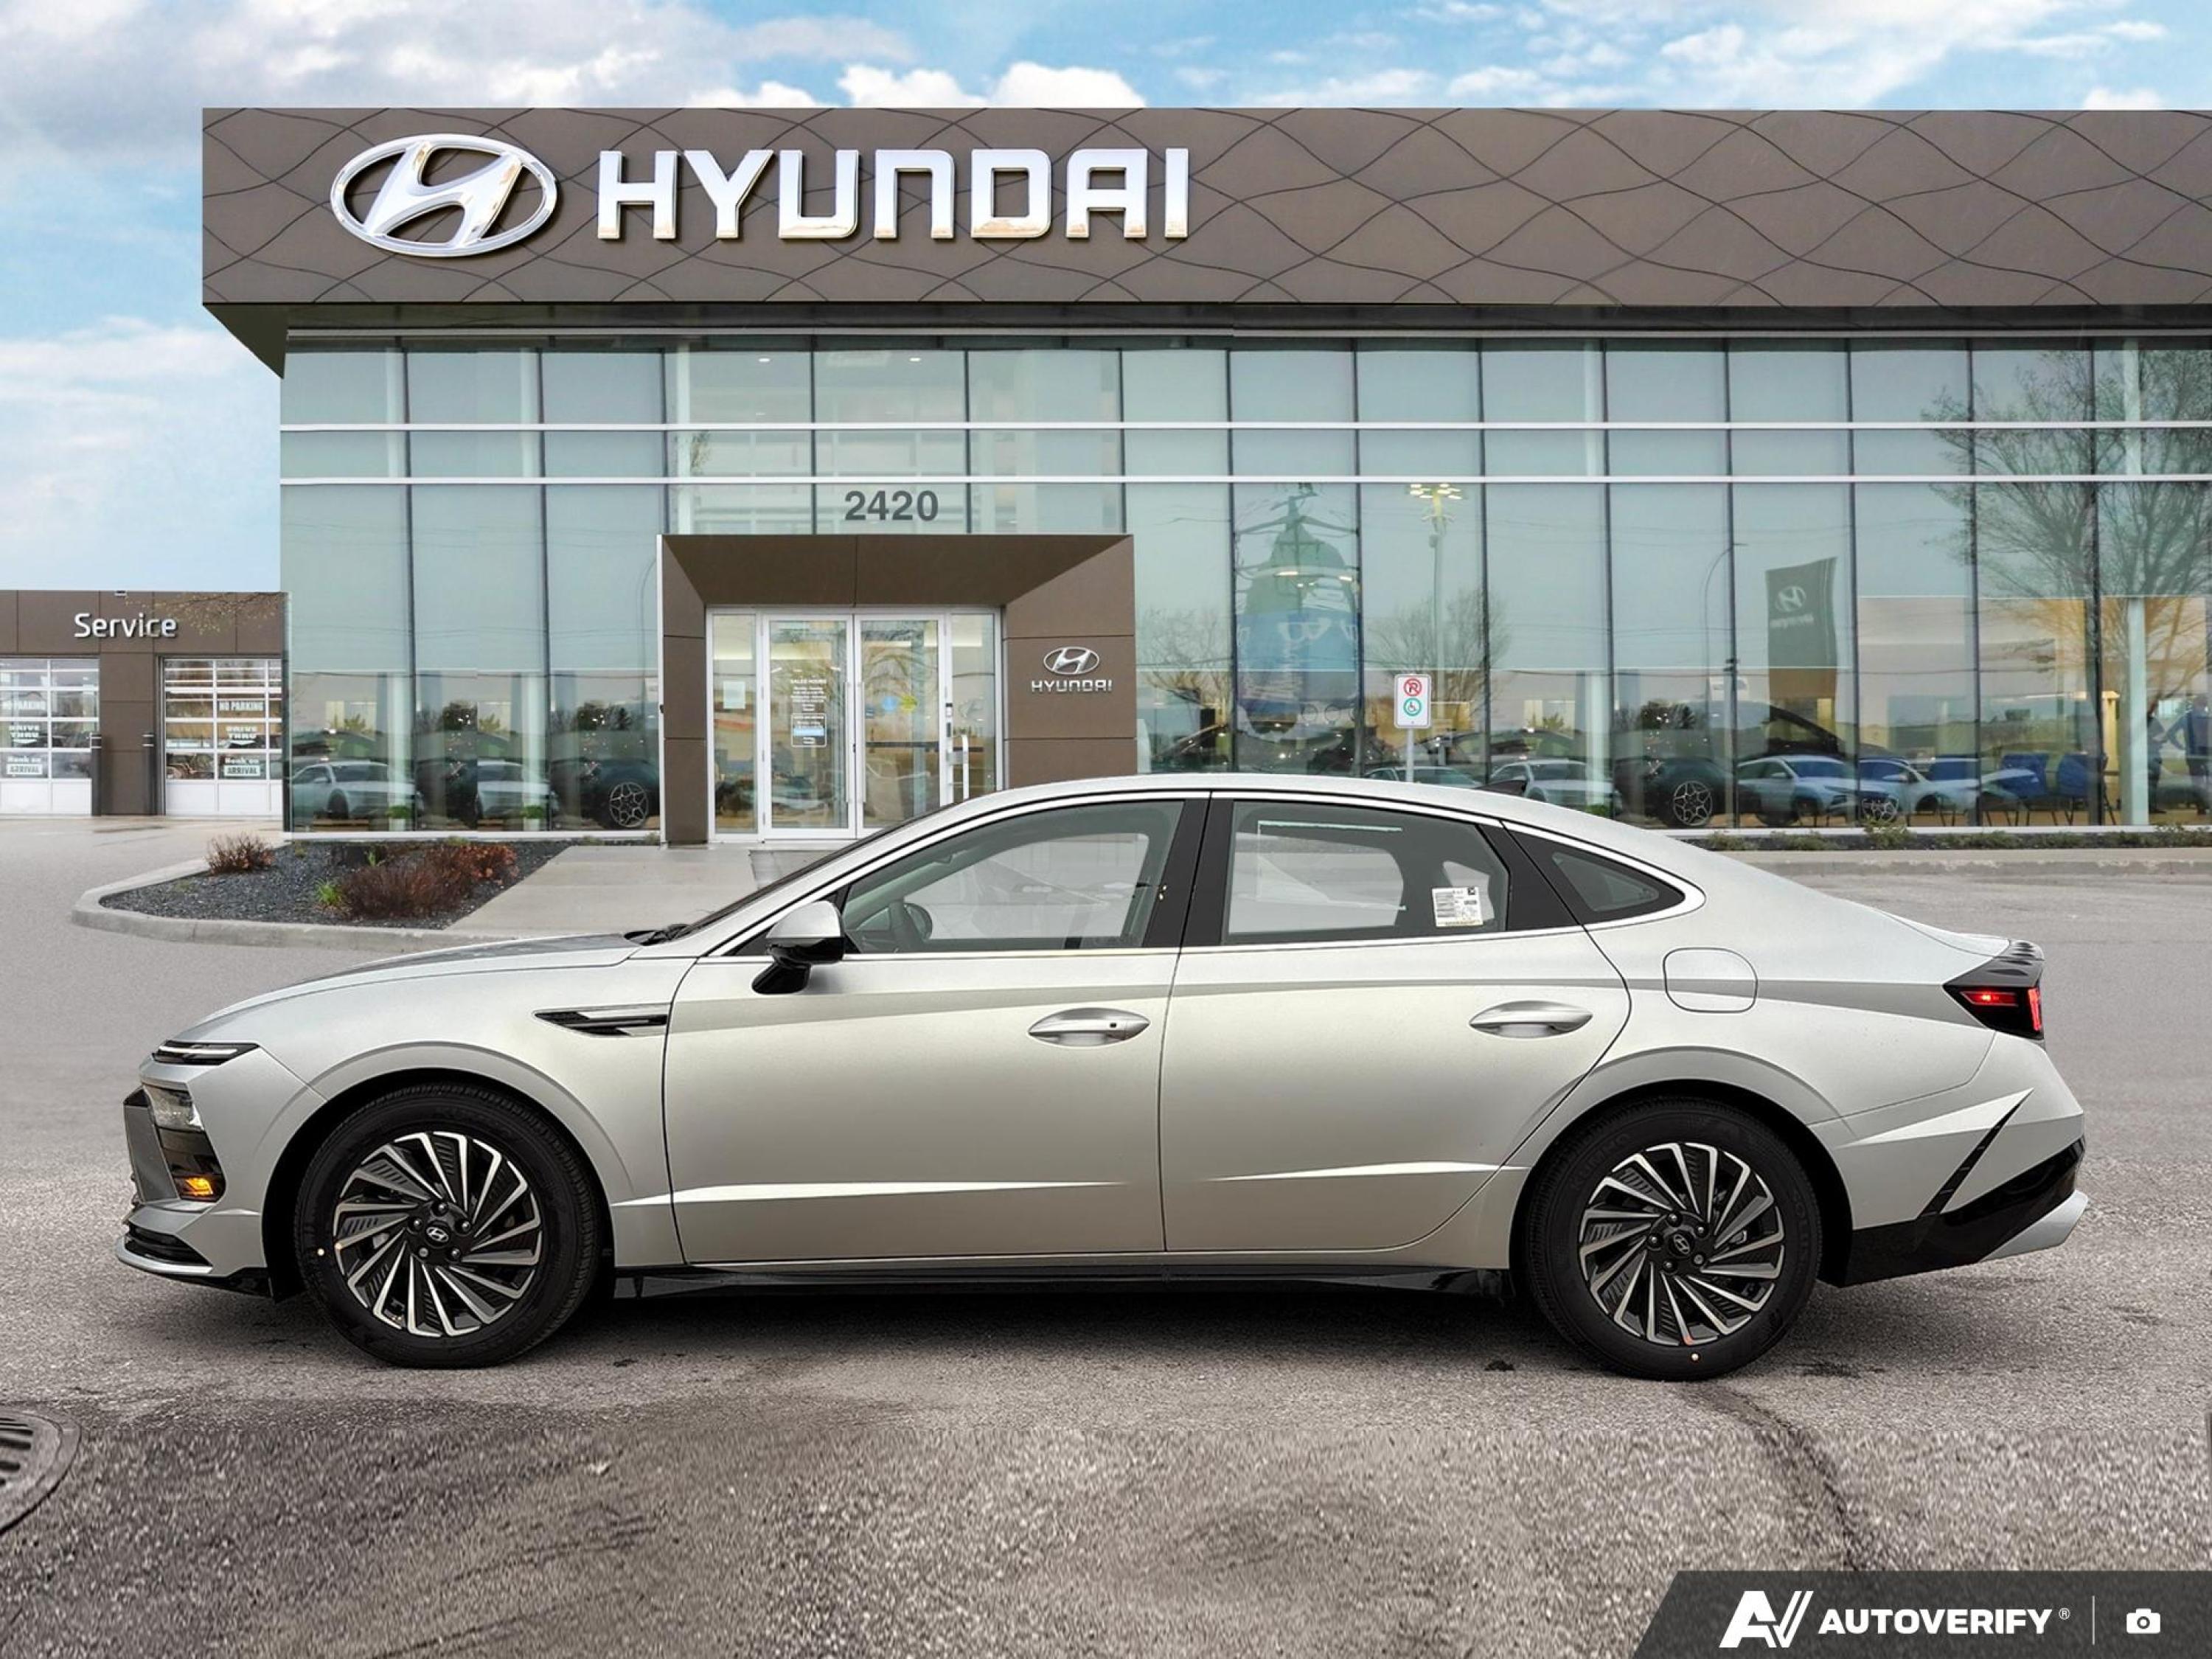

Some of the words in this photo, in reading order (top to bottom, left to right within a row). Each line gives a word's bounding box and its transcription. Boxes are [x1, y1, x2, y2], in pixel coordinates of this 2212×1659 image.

[598, 148, 1189, 240] HYUNDAI
[845, 490, 939, 521] 2420
[74, 612, 177, 638] Service
[1032, 679, 1112, 692] HYUNDAI
